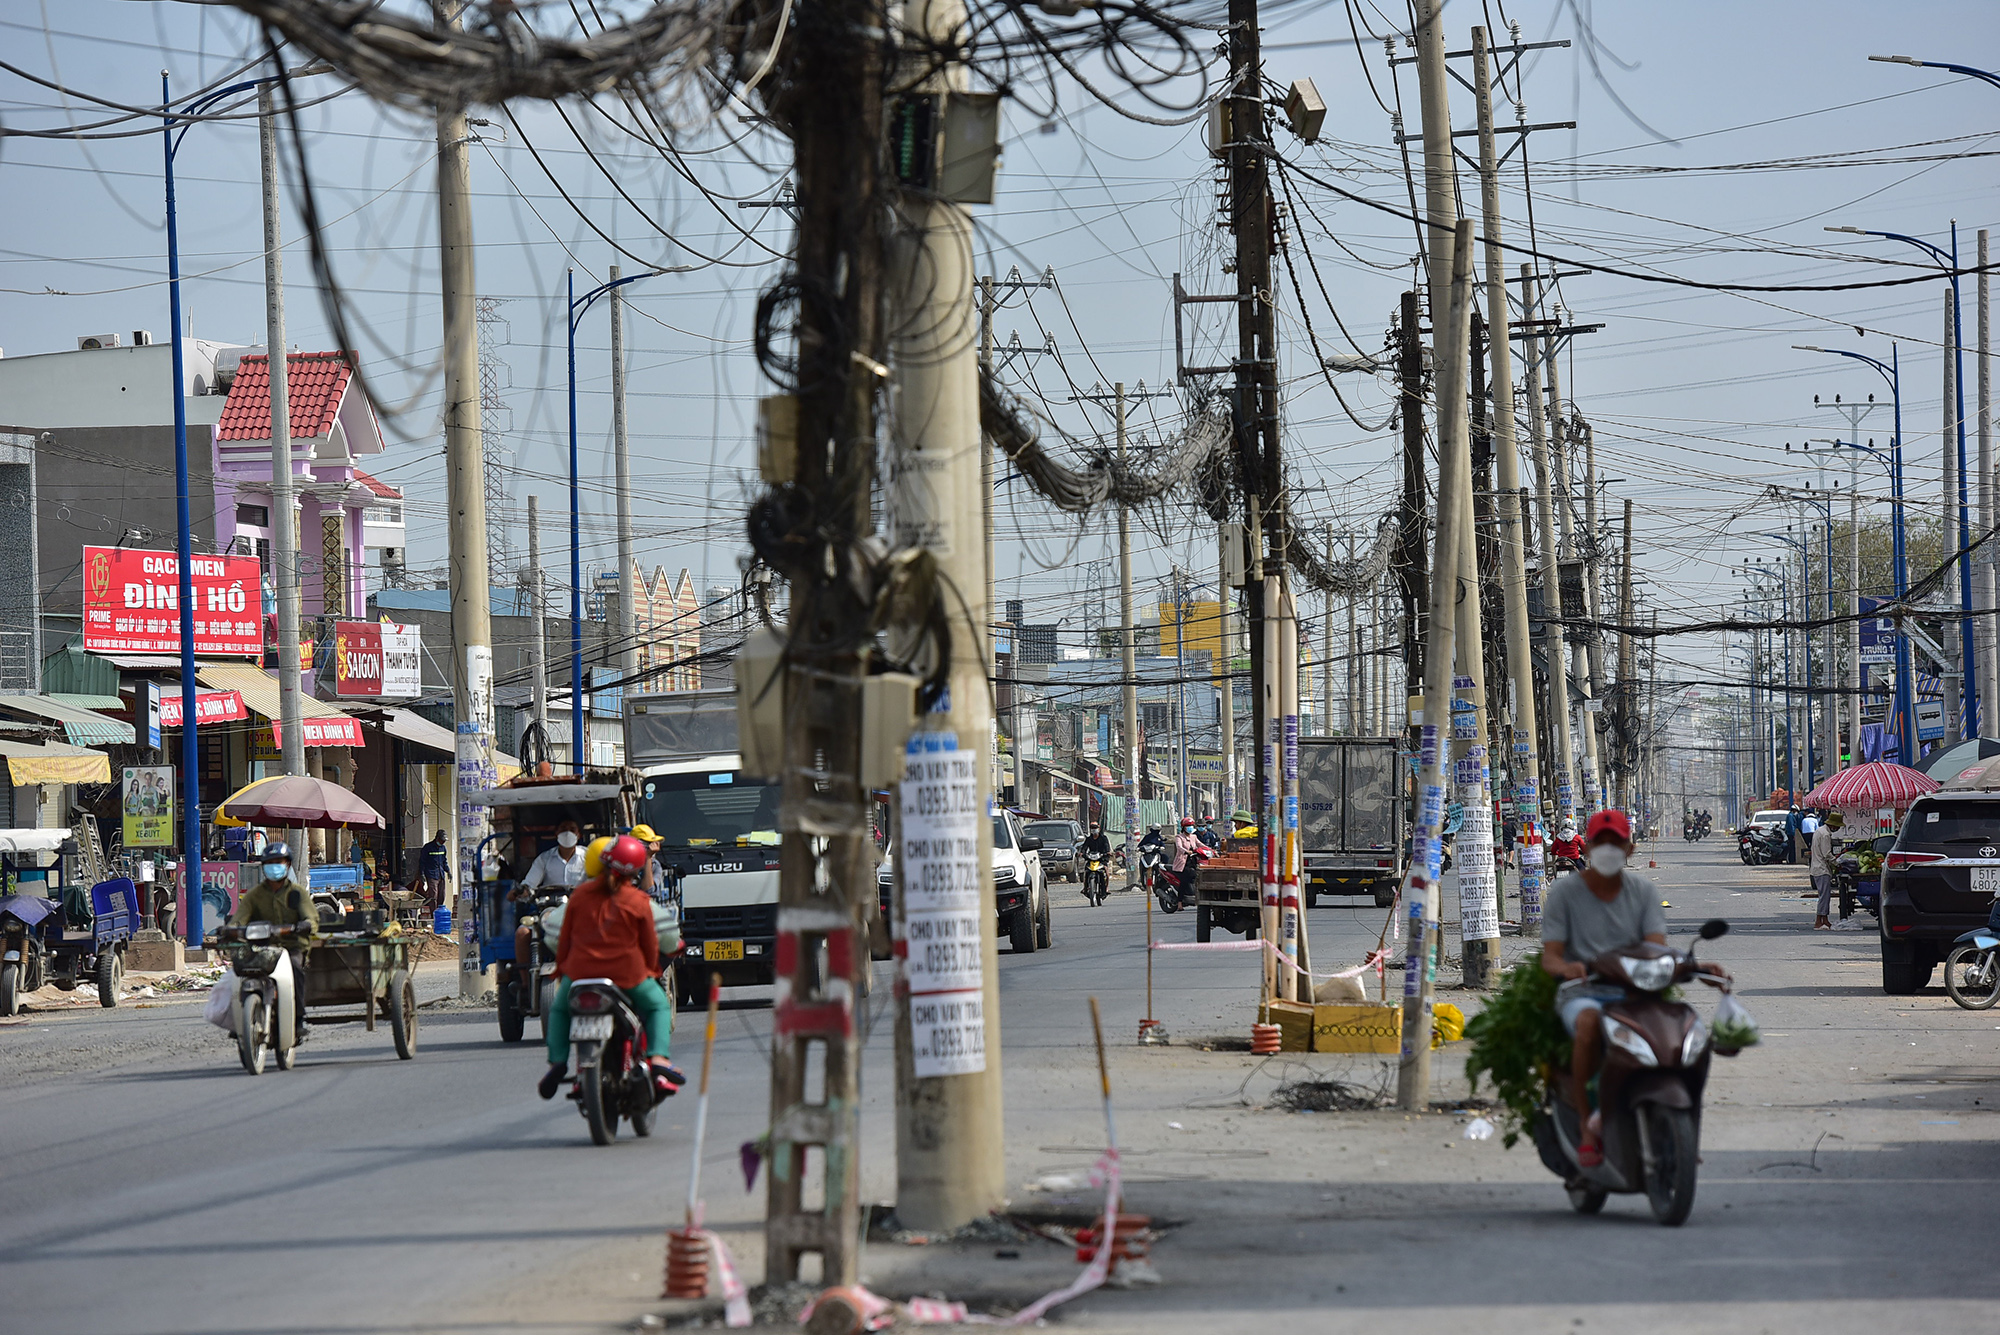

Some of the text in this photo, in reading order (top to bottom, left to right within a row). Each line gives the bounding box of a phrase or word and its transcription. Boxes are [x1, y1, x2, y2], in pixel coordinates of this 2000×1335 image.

[191, 560, 225, 577] MEN
[207, 580, 246, 613] HỒ
[89, 610, 111, 623] PRIME
[347, 651, 380, 679] SAIGON
[926, 760, 949, 779] VAY
[1301, 802, 1333, 811] 1D-575.28
[135, 830, 144, 838] XE
[1842, 824, 1857, 837] 15
[907, 839, 929, 859] CHO
[932, 838, 954, 858] VAY
[699, 862, 743, 873] ISUZU
[209, 866, 235, 889] TÓC
[1978, 869, 1997, 880] 51F
[1972, 880, 2000, 891] 480.2
[911, 919, 934, 940] CHO
[936, 918, 958, 939] VAY
[715, 941, 732, 951] 29H
[708, 951, 739, 960] 701.56
[915, 1006, 939, 1026] CHO
[941, 1003, 962, 1023] VAY
